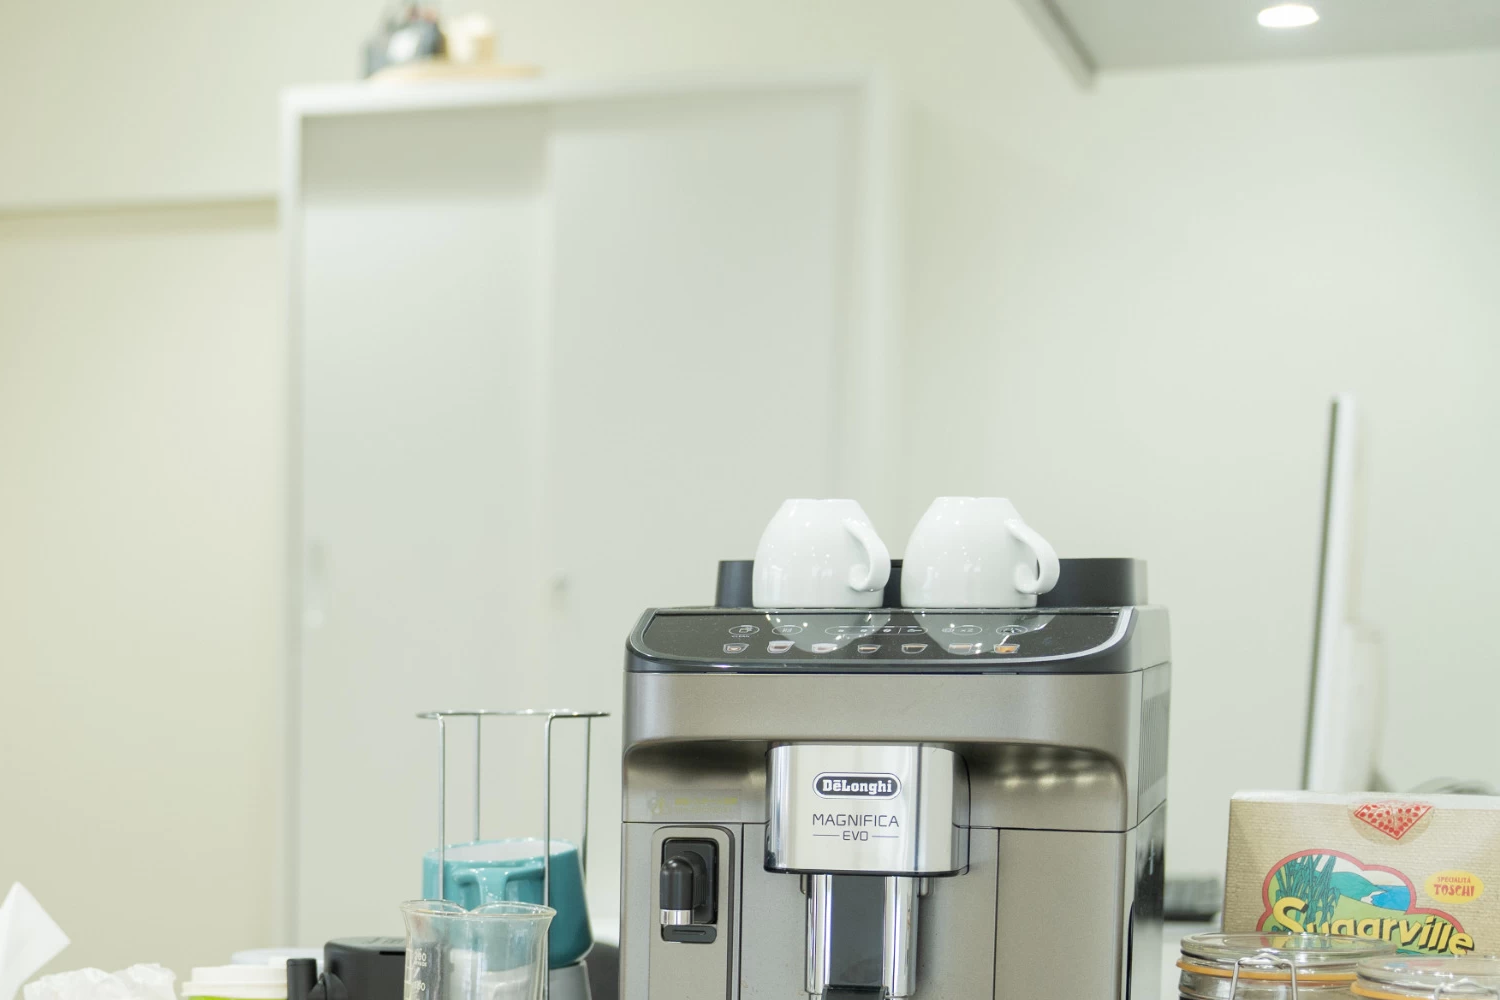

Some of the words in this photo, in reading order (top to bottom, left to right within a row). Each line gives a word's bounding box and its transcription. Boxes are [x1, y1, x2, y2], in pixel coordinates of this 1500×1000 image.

[812, 813, 900, 827] MAGNIFICA
[842, 830, 869, 841] EVO
[1434, 883, 1475, 897] TOSCHI
